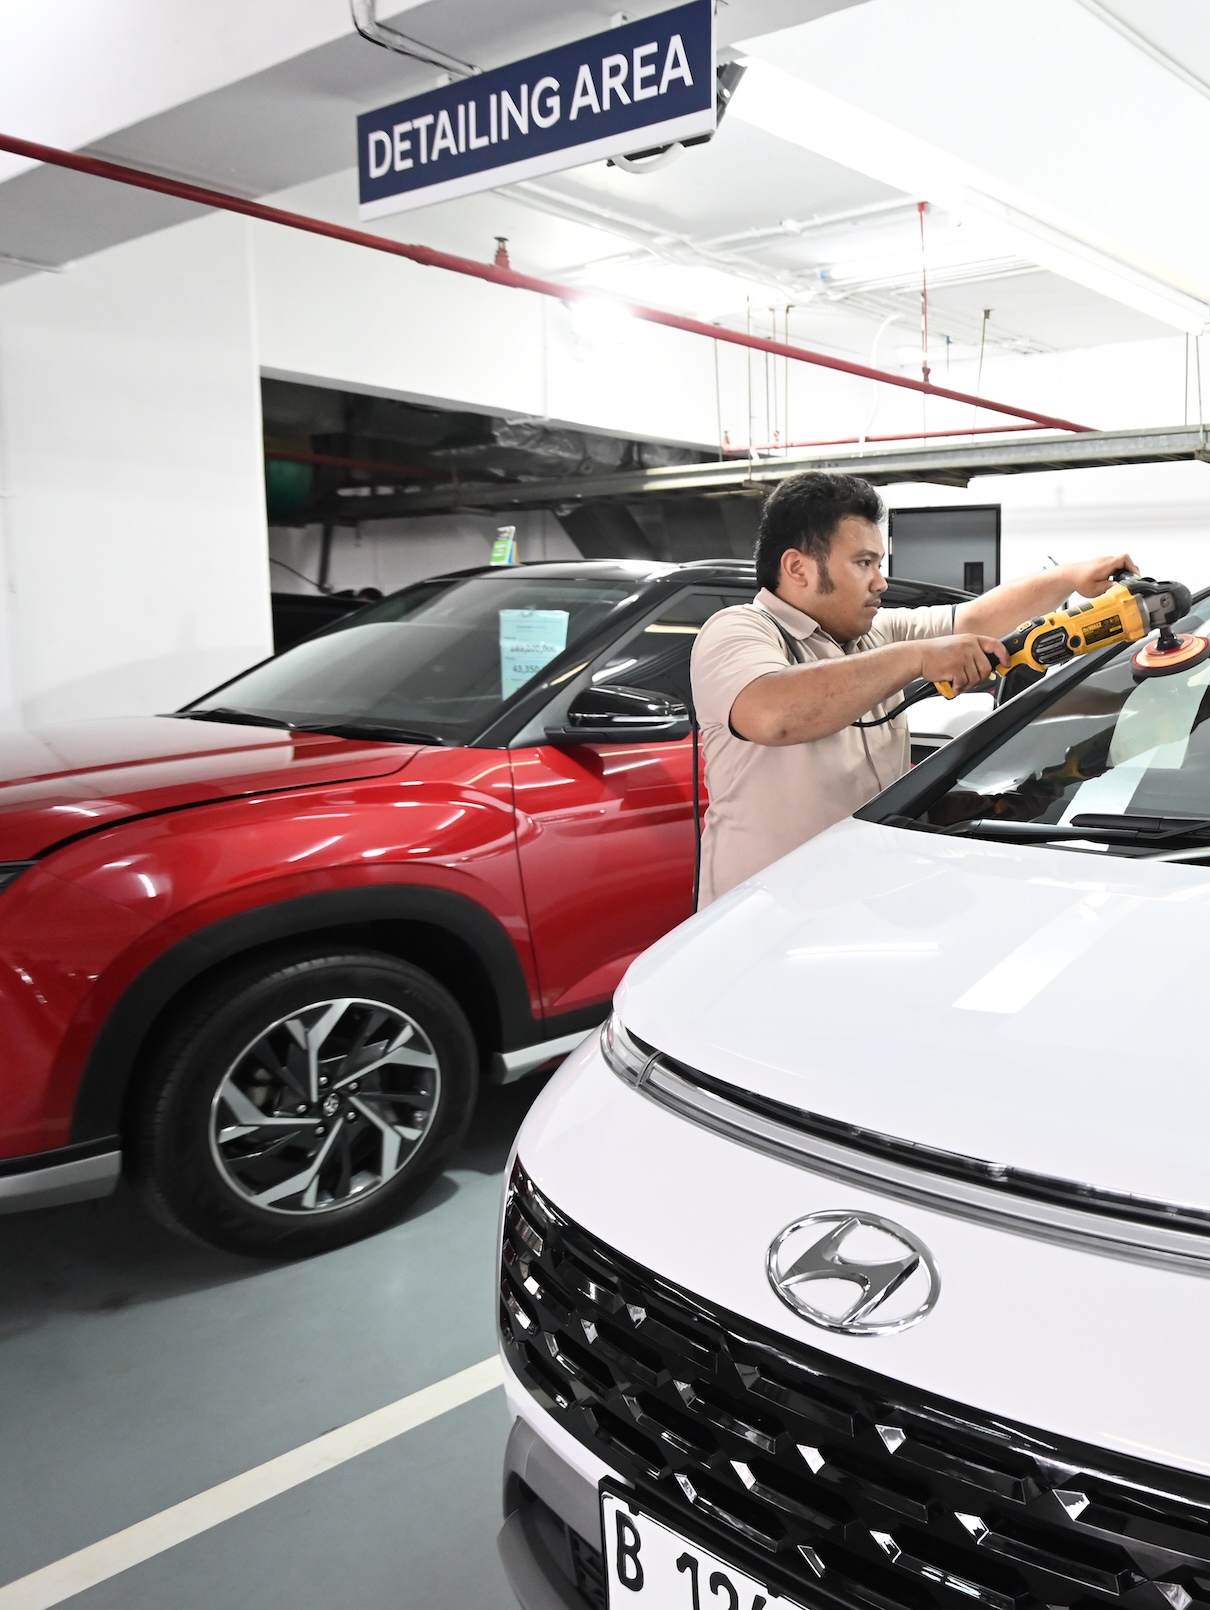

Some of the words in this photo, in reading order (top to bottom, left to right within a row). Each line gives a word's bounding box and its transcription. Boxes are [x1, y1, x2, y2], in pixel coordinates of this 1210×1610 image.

[368, 75, 561, 180] DETAILING
[569, 34, 694, 121] AREA
[616, 1509, 644, 1591] B
[676, 1552, 767, 1610] 12
